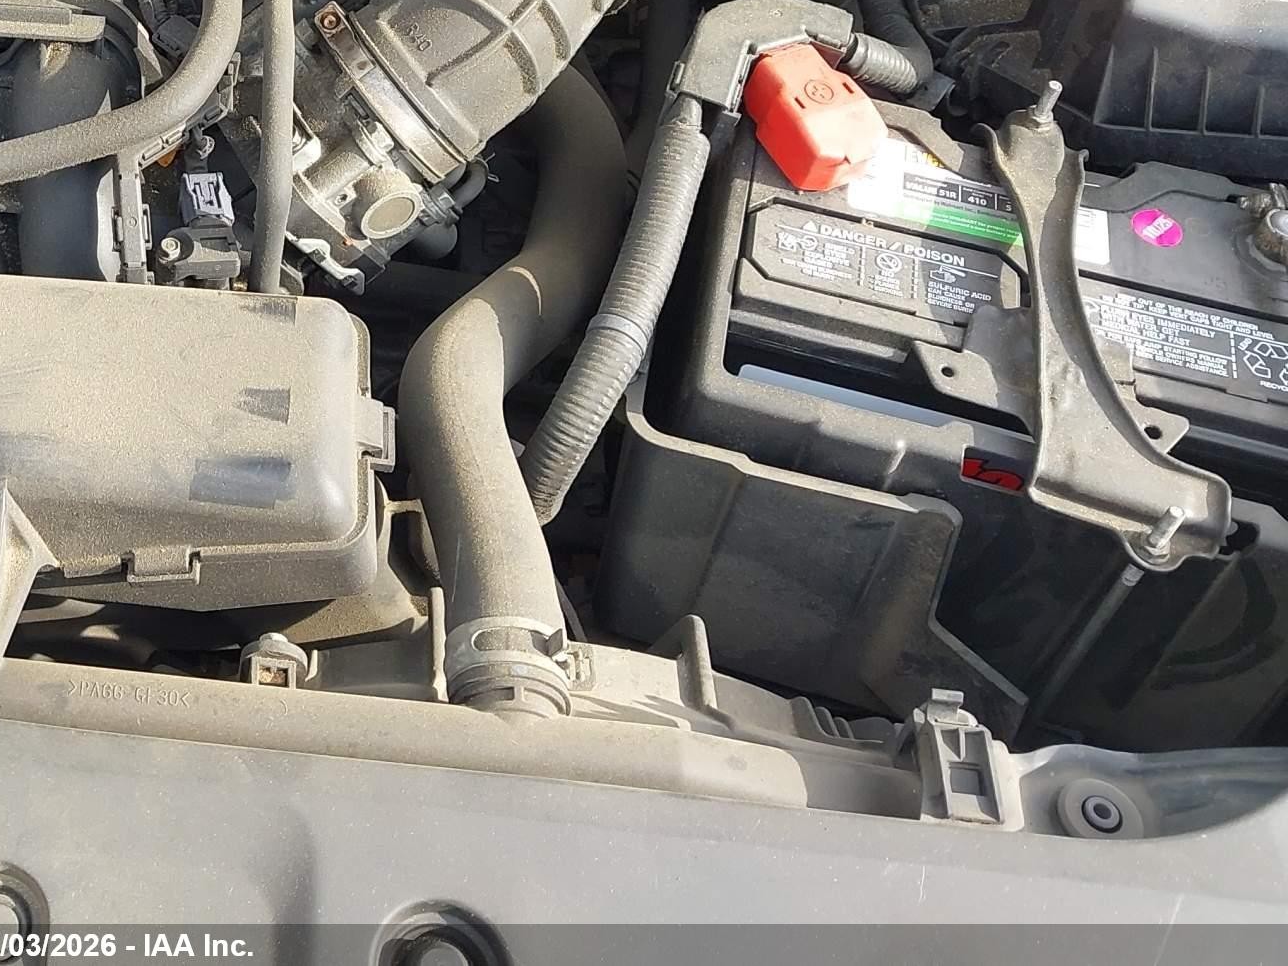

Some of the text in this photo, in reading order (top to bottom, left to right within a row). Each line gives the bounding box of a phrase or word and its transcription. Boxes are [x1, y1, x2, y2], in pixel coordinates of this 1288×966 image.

[938, 189, 958, 200] 51R
[967, 195, 987, 206] 410
[820, 223, 892, 249] DANGER
[903, 244, 966, 268] POISON
[928, 281, 992, 301] SULFURIC ACID
[1156, 318, 1216, 339] IMMEDIATELY
[1167, 335, 1191, 347] FAST
